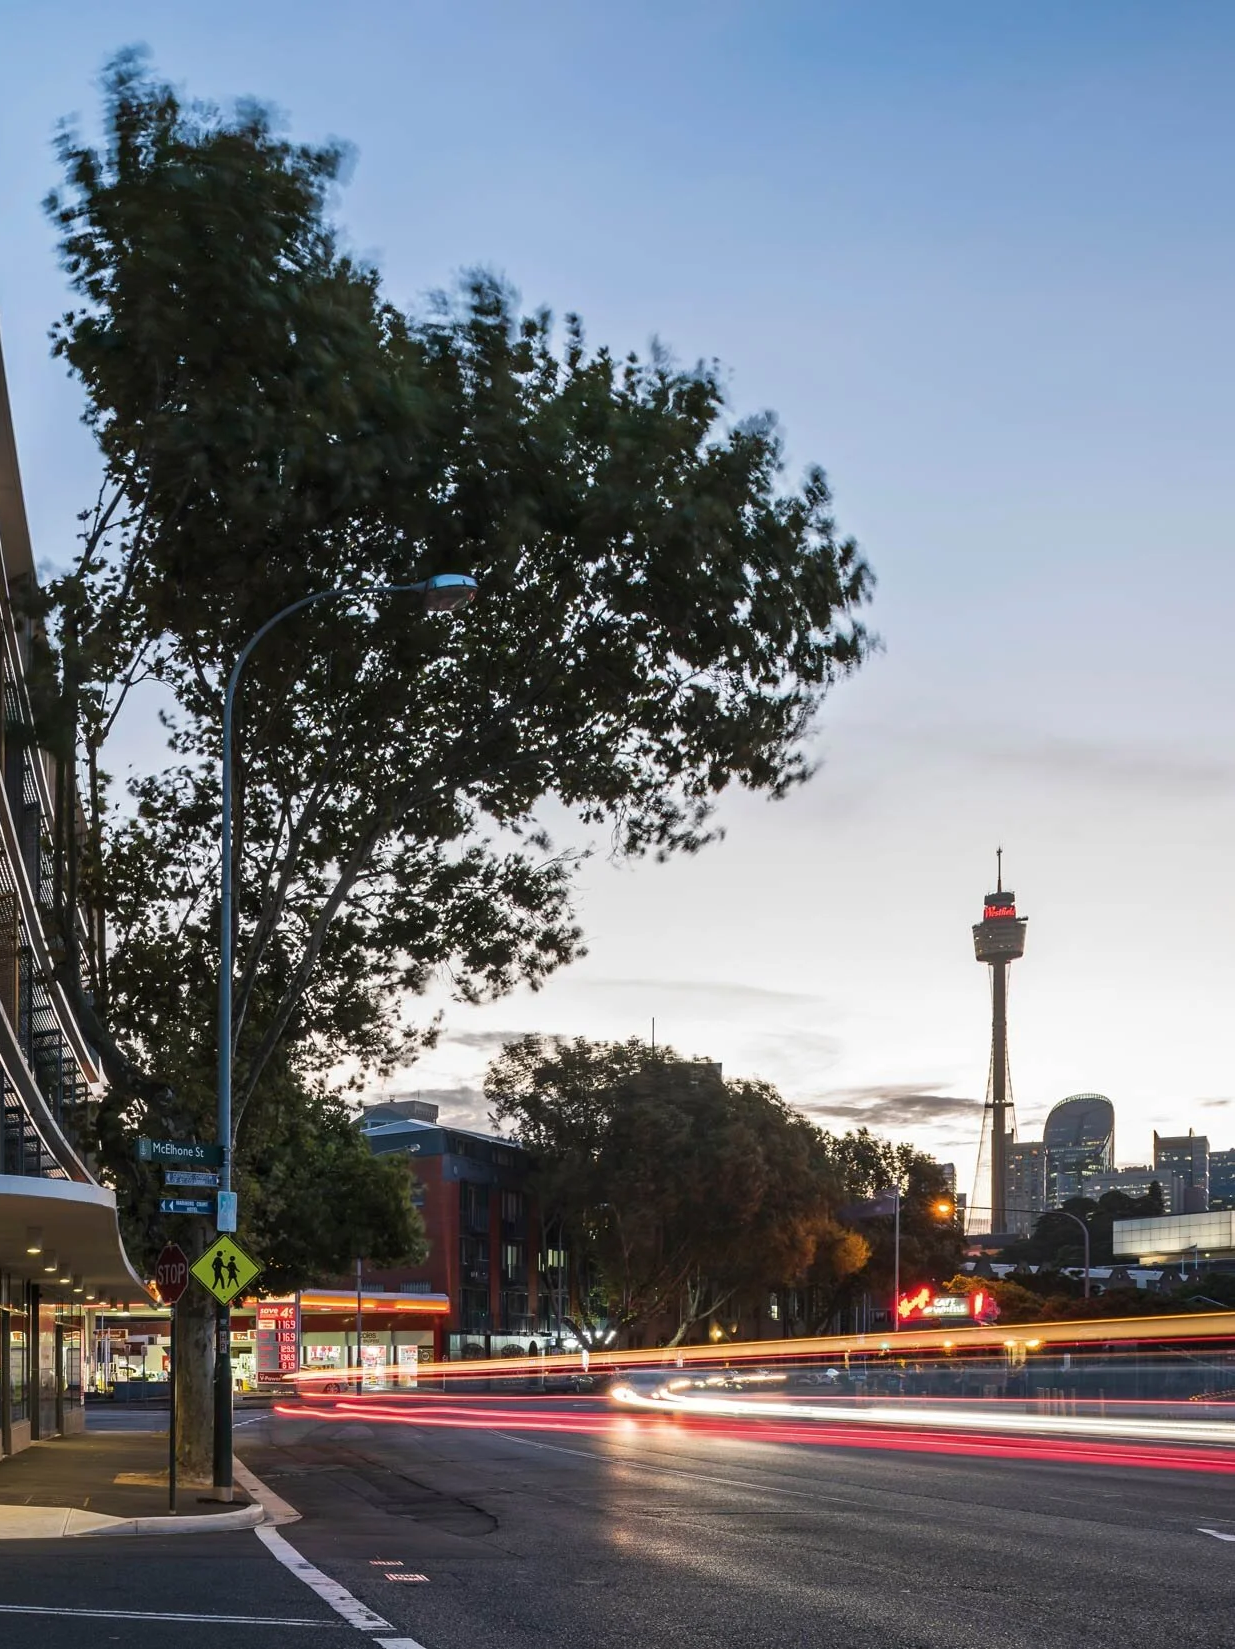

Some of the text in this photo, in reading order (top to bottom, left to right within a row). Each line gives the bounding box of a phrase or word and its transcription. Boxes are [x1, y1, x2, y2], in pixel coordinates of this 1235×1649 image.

[152, 1142, 194, 1157] McElhone
[195, 1145, 205, 1158] St
[157, 1262, 185, 1285] STOP
[259, 1307, 279, 1315] save
